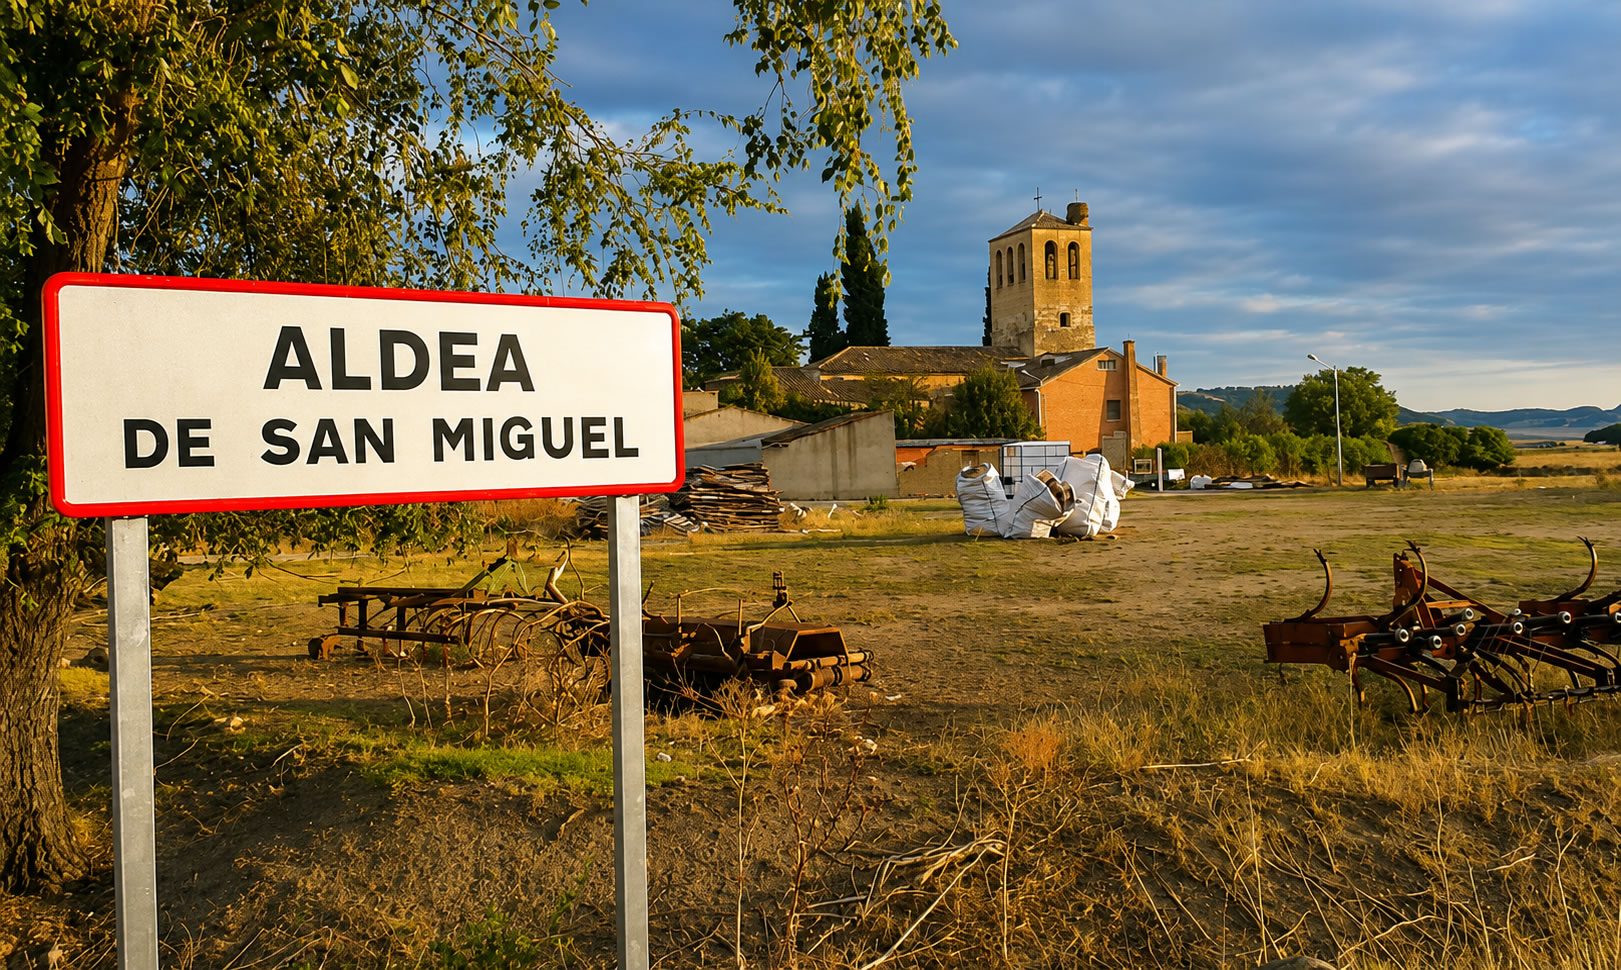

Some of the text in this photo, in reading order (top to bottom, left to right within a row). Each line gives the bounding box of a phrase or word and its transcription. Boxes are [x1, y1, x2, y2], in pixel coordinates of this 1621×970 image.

[263, 325, 535, 392] ALDEA
[123, 415, 640, 469] DE SAN MIGUEL
